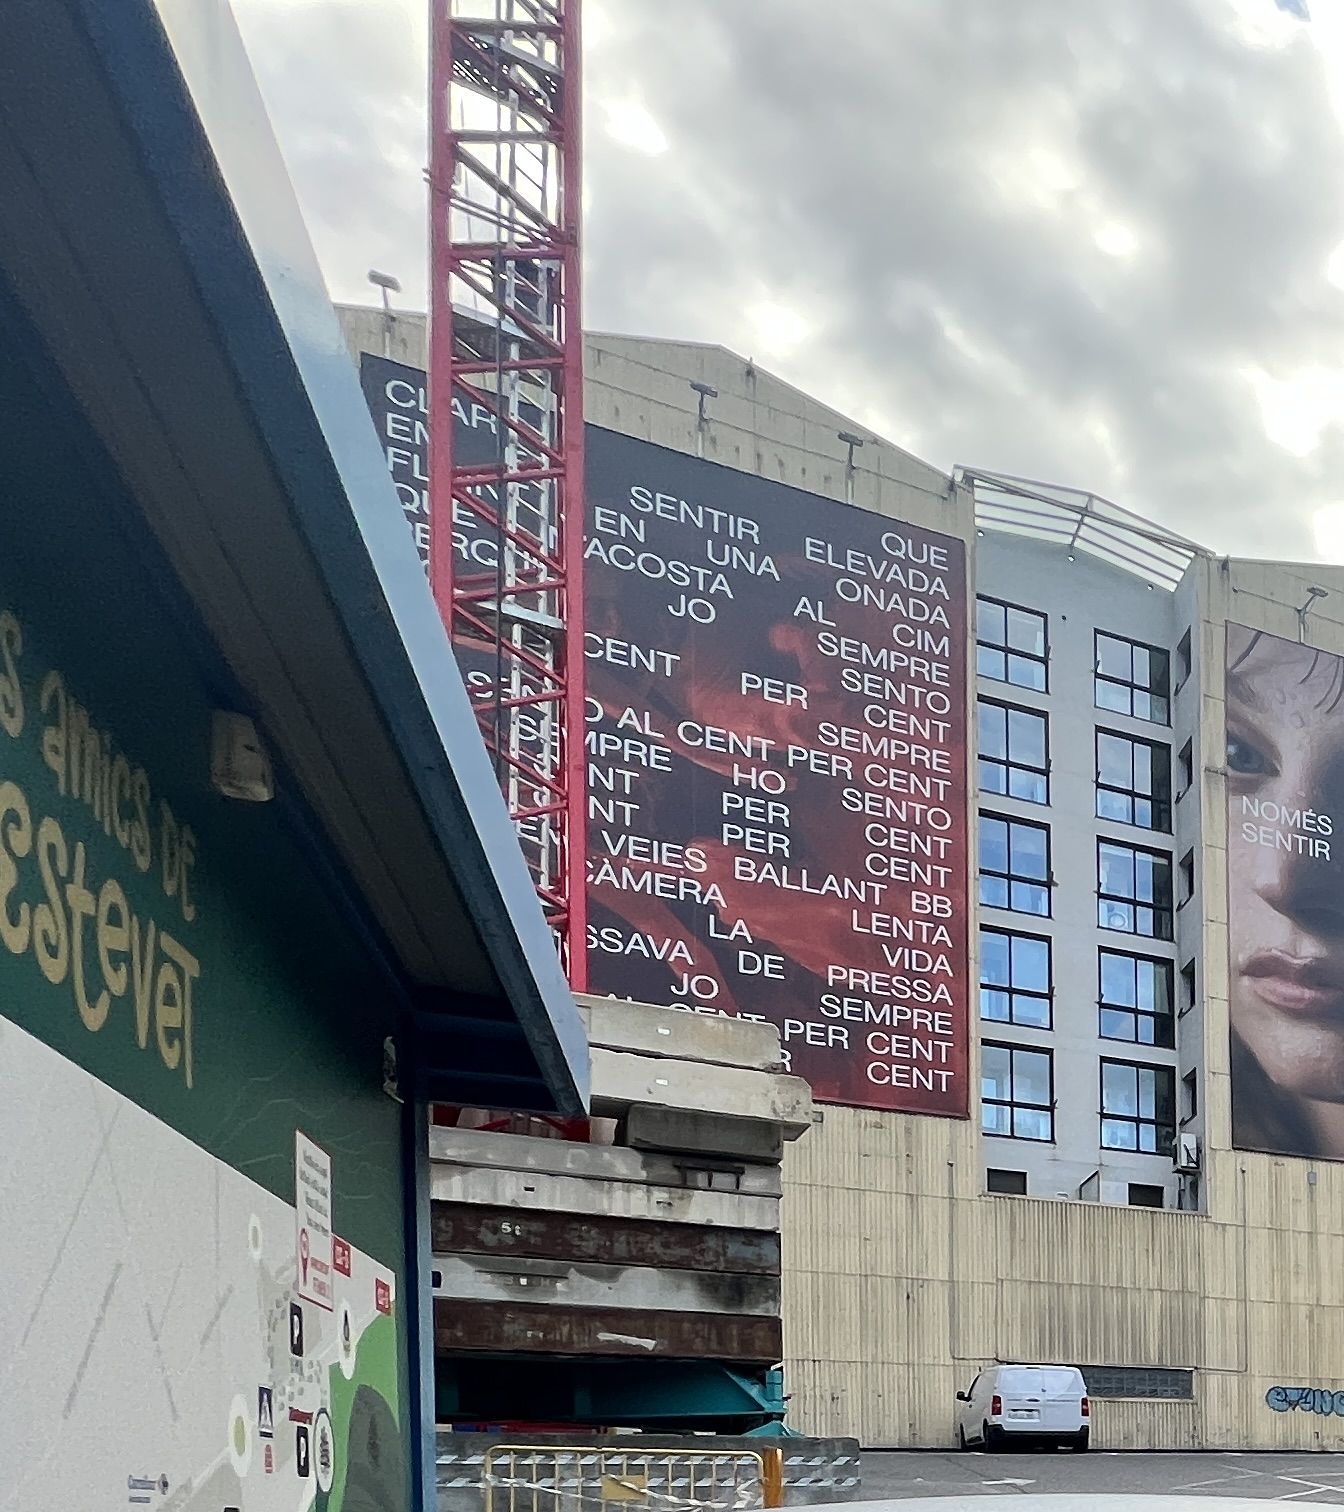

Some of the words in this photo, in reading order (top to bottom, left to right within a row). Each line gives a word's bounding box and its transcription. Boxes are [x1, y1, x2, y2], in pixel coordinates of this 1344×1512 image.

[594, 505, 645, 543] EN
[707, 539, 781, 582] UNA
[835, 577, 950, 630] ONADA
[630, 486, 760, 544] SENTIR
[805, 536, 950, 601] ELEVADA
[881, 532, 949, 571] QUE
[668, 594, 717, 624] JO
[817, 631, 950, 688] SEMPRE
[793, 596, 837, 628] AL
[892, 623, 950, 659] CIM
[584, 632, 681, 677] CENT
[741, 672, 809, 711] PER
[863, 704, 951, 743] CENT
[840, 668, 951, 716] SENTO
[616, 707, 665, 739] AL
[677, 720, 776, 762] CENT
[787, 744, 853, 781] PER
[863, 764, 952, 802] CENT
[817, 721, 951, 774] SEMPRE
[588, 762, 640, 795] NT
[722, 791, 791, 828] PER
[864, 823, 953, 859] CENT
[733, 763, 787, 796] HO
[841, 787, 952, 831] SENTO
[1241, 795, 1335, 836] NOMÉS
[588, 795, 640, 827] NT
[722, 823, 791, 859] PER
[865, 852, 953, 889] CENT
[601, 829, 709, 874] VEIES
[734, 856, 888, 906] BALLANT
[911, 890, 953, 919] BB
[1241, 822, 1332, 862] SENTIR
[708, 914, 753, 944] LA
[882, 944, 954, 978] VIDA
[852, 909, 954, 949] LENTA
[670, 972, 720, 1000] JO
[819, 994, 954, 1036] SEMPRE
[738, 950, 786, 979] DE
[827, 965, 955, 1007] PRESSA
[784, 1018, 850, 1050] PER
[866, 1031, 955, 1064] CENT
[866, 1062, 955, 1093] CENT
